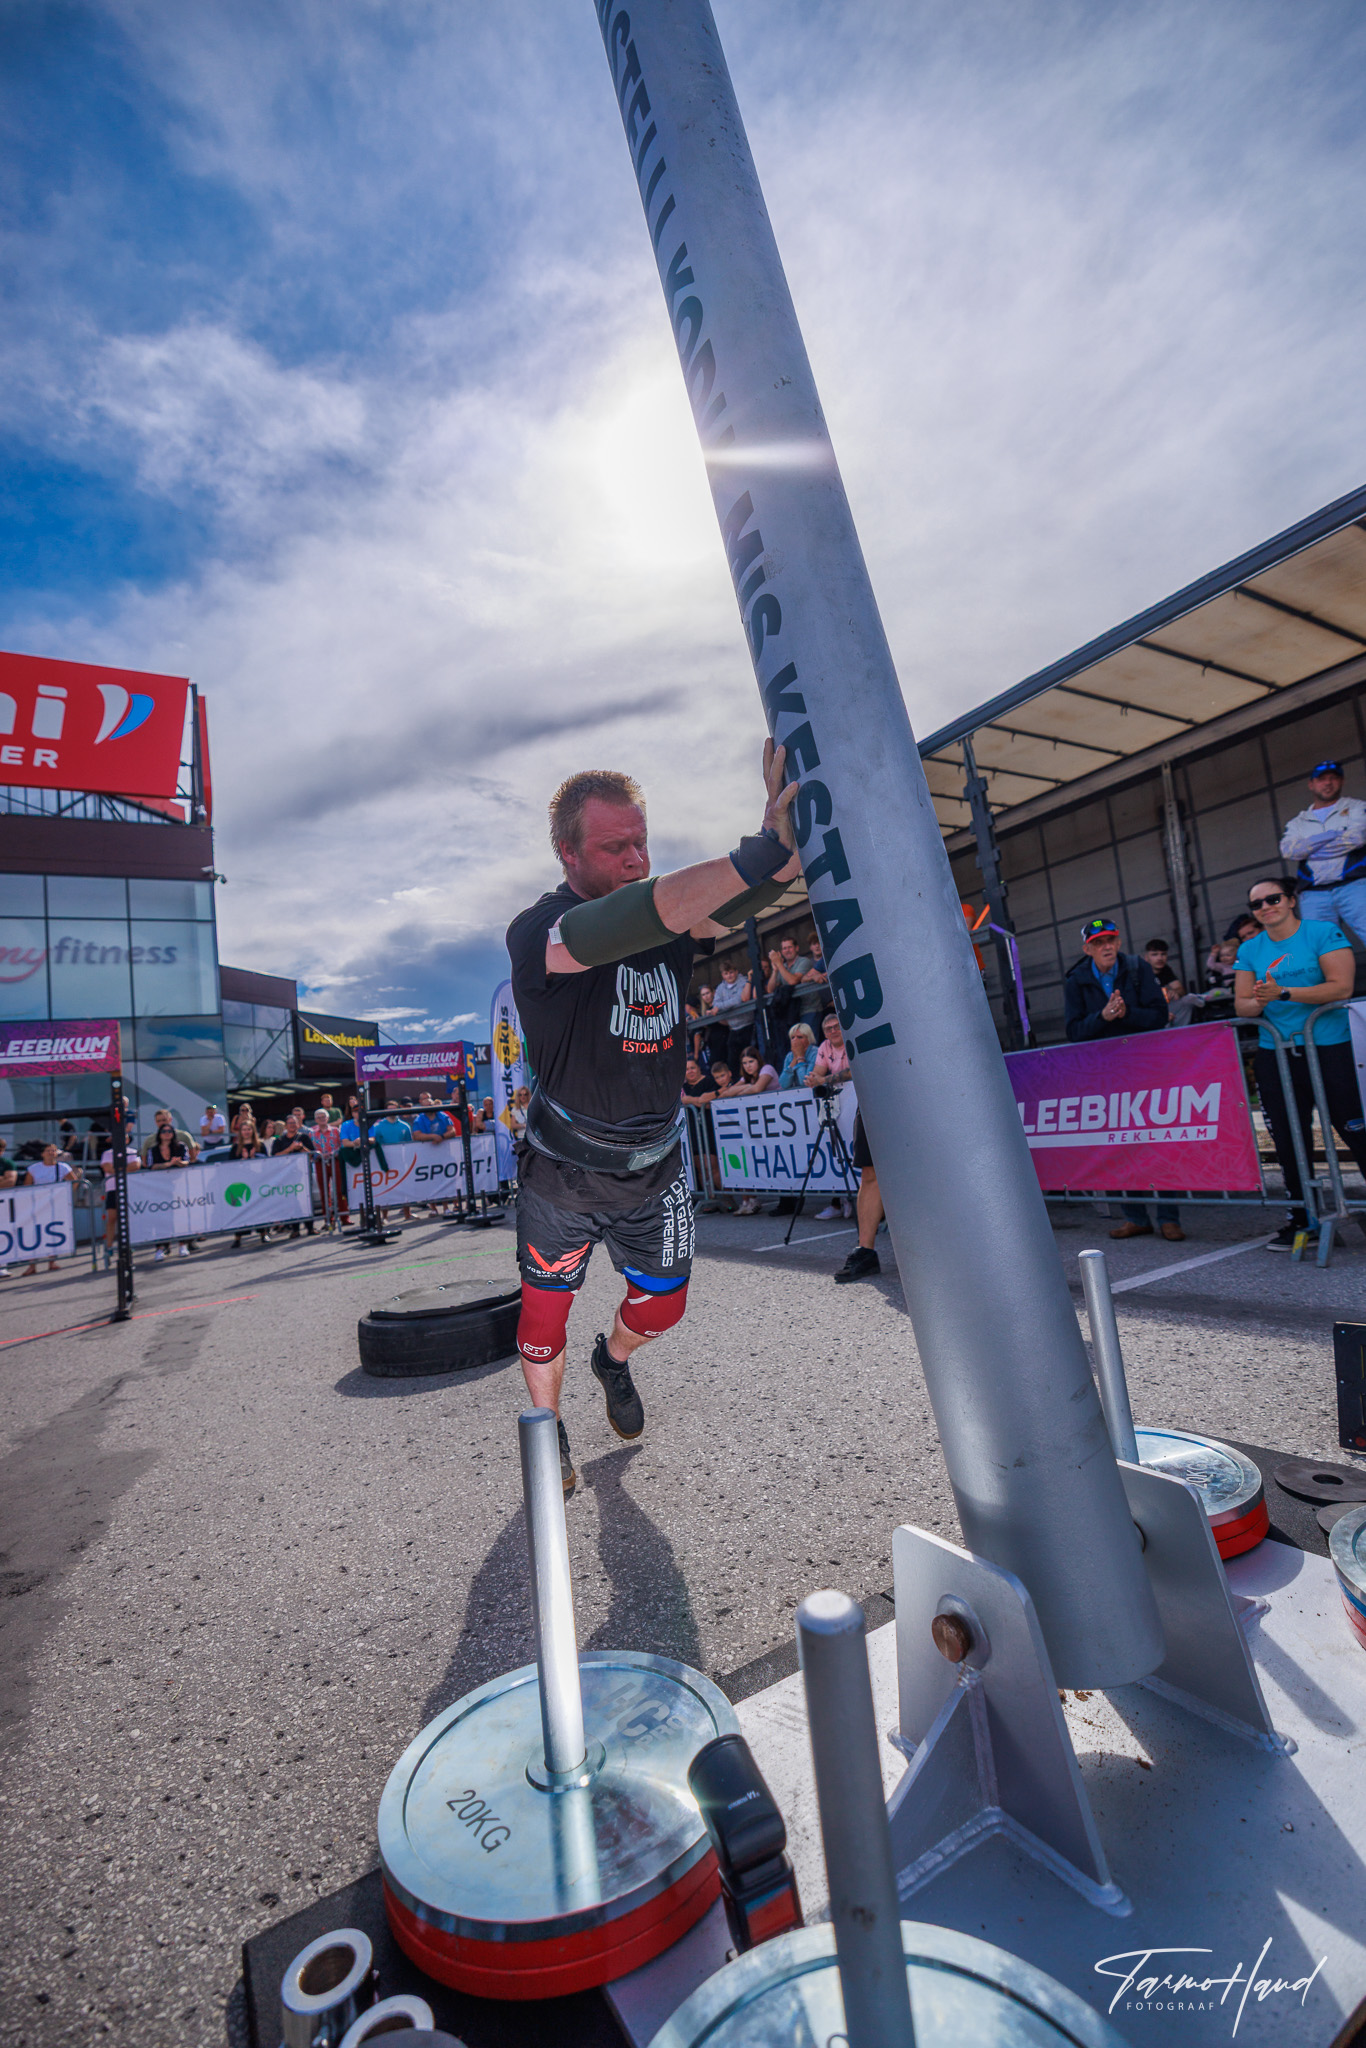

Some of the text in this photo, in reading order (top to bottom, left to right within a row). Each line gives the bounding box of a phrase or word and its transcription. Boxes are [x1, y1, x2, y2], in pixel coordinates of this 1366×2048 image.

[765, 661, 896, 1061] KESTAB!
[389, 1051, 459, 1066] KLEEBIKUM
[466, 1054, 475, 1079] 5
[1108, 1128, 1208, 1143] REKLAAM
[127, 1192, 216, 1215] Woodwell
[258, 1182, 304, 1198] Grupp
[661, 1194, 675, 1268] ETREMES
[677, 1205, 689, 1259] GOING
[634, 1716, 686, 1752] PRO
[446, 1789, 511, 1854] 20KG
